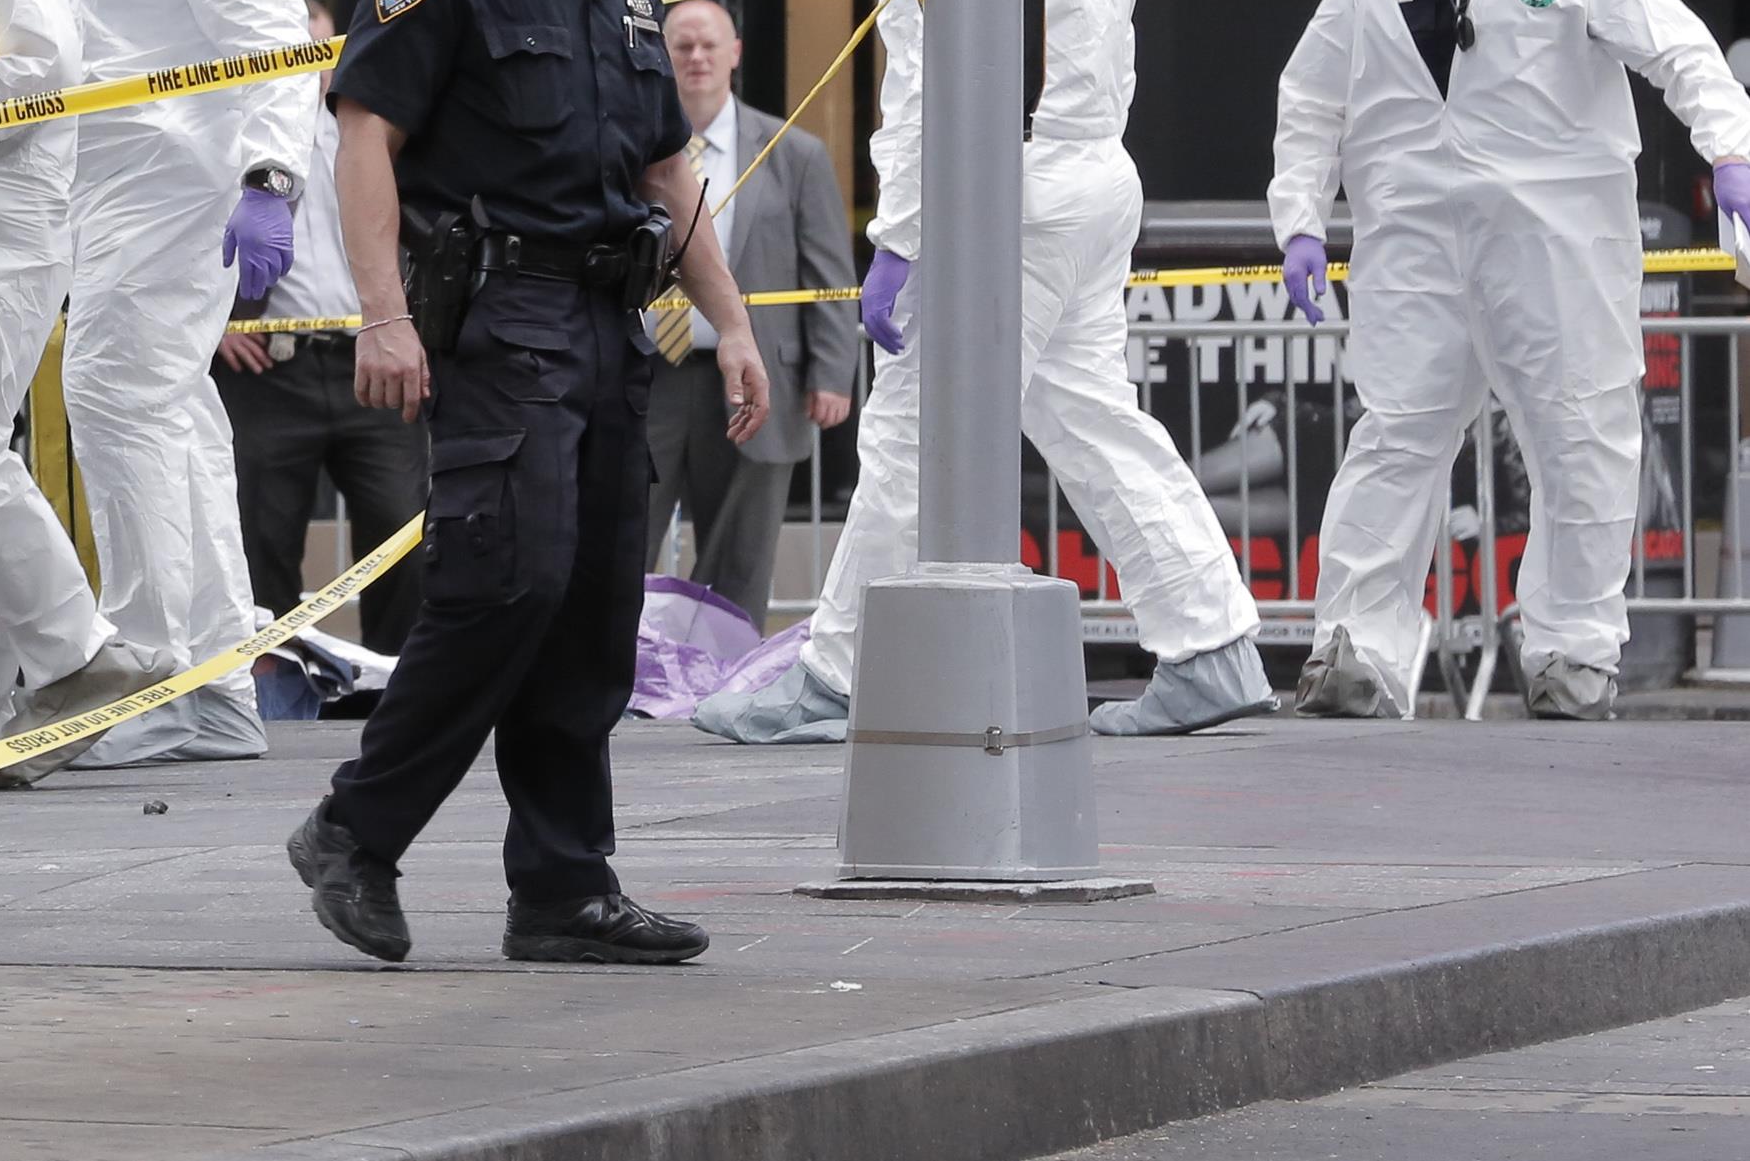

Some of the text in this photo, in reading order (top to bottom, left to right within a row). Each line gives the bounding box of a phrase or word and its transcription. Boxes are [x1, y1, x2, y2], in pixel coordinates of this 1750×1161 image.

[148, 39, 333, 94] FIRE LINE DO NOT CROSS
[14, 91, 65, 120] CROSS
[1127, 335, 1356, 384] E THIN
[307, 597, 333, 612] DO
[281, 611, 310, 631] NOT
[236, 628, 286, 656] CROSS
[6, 685, 176, 753] FIRE LINE DO NOT CROSS
